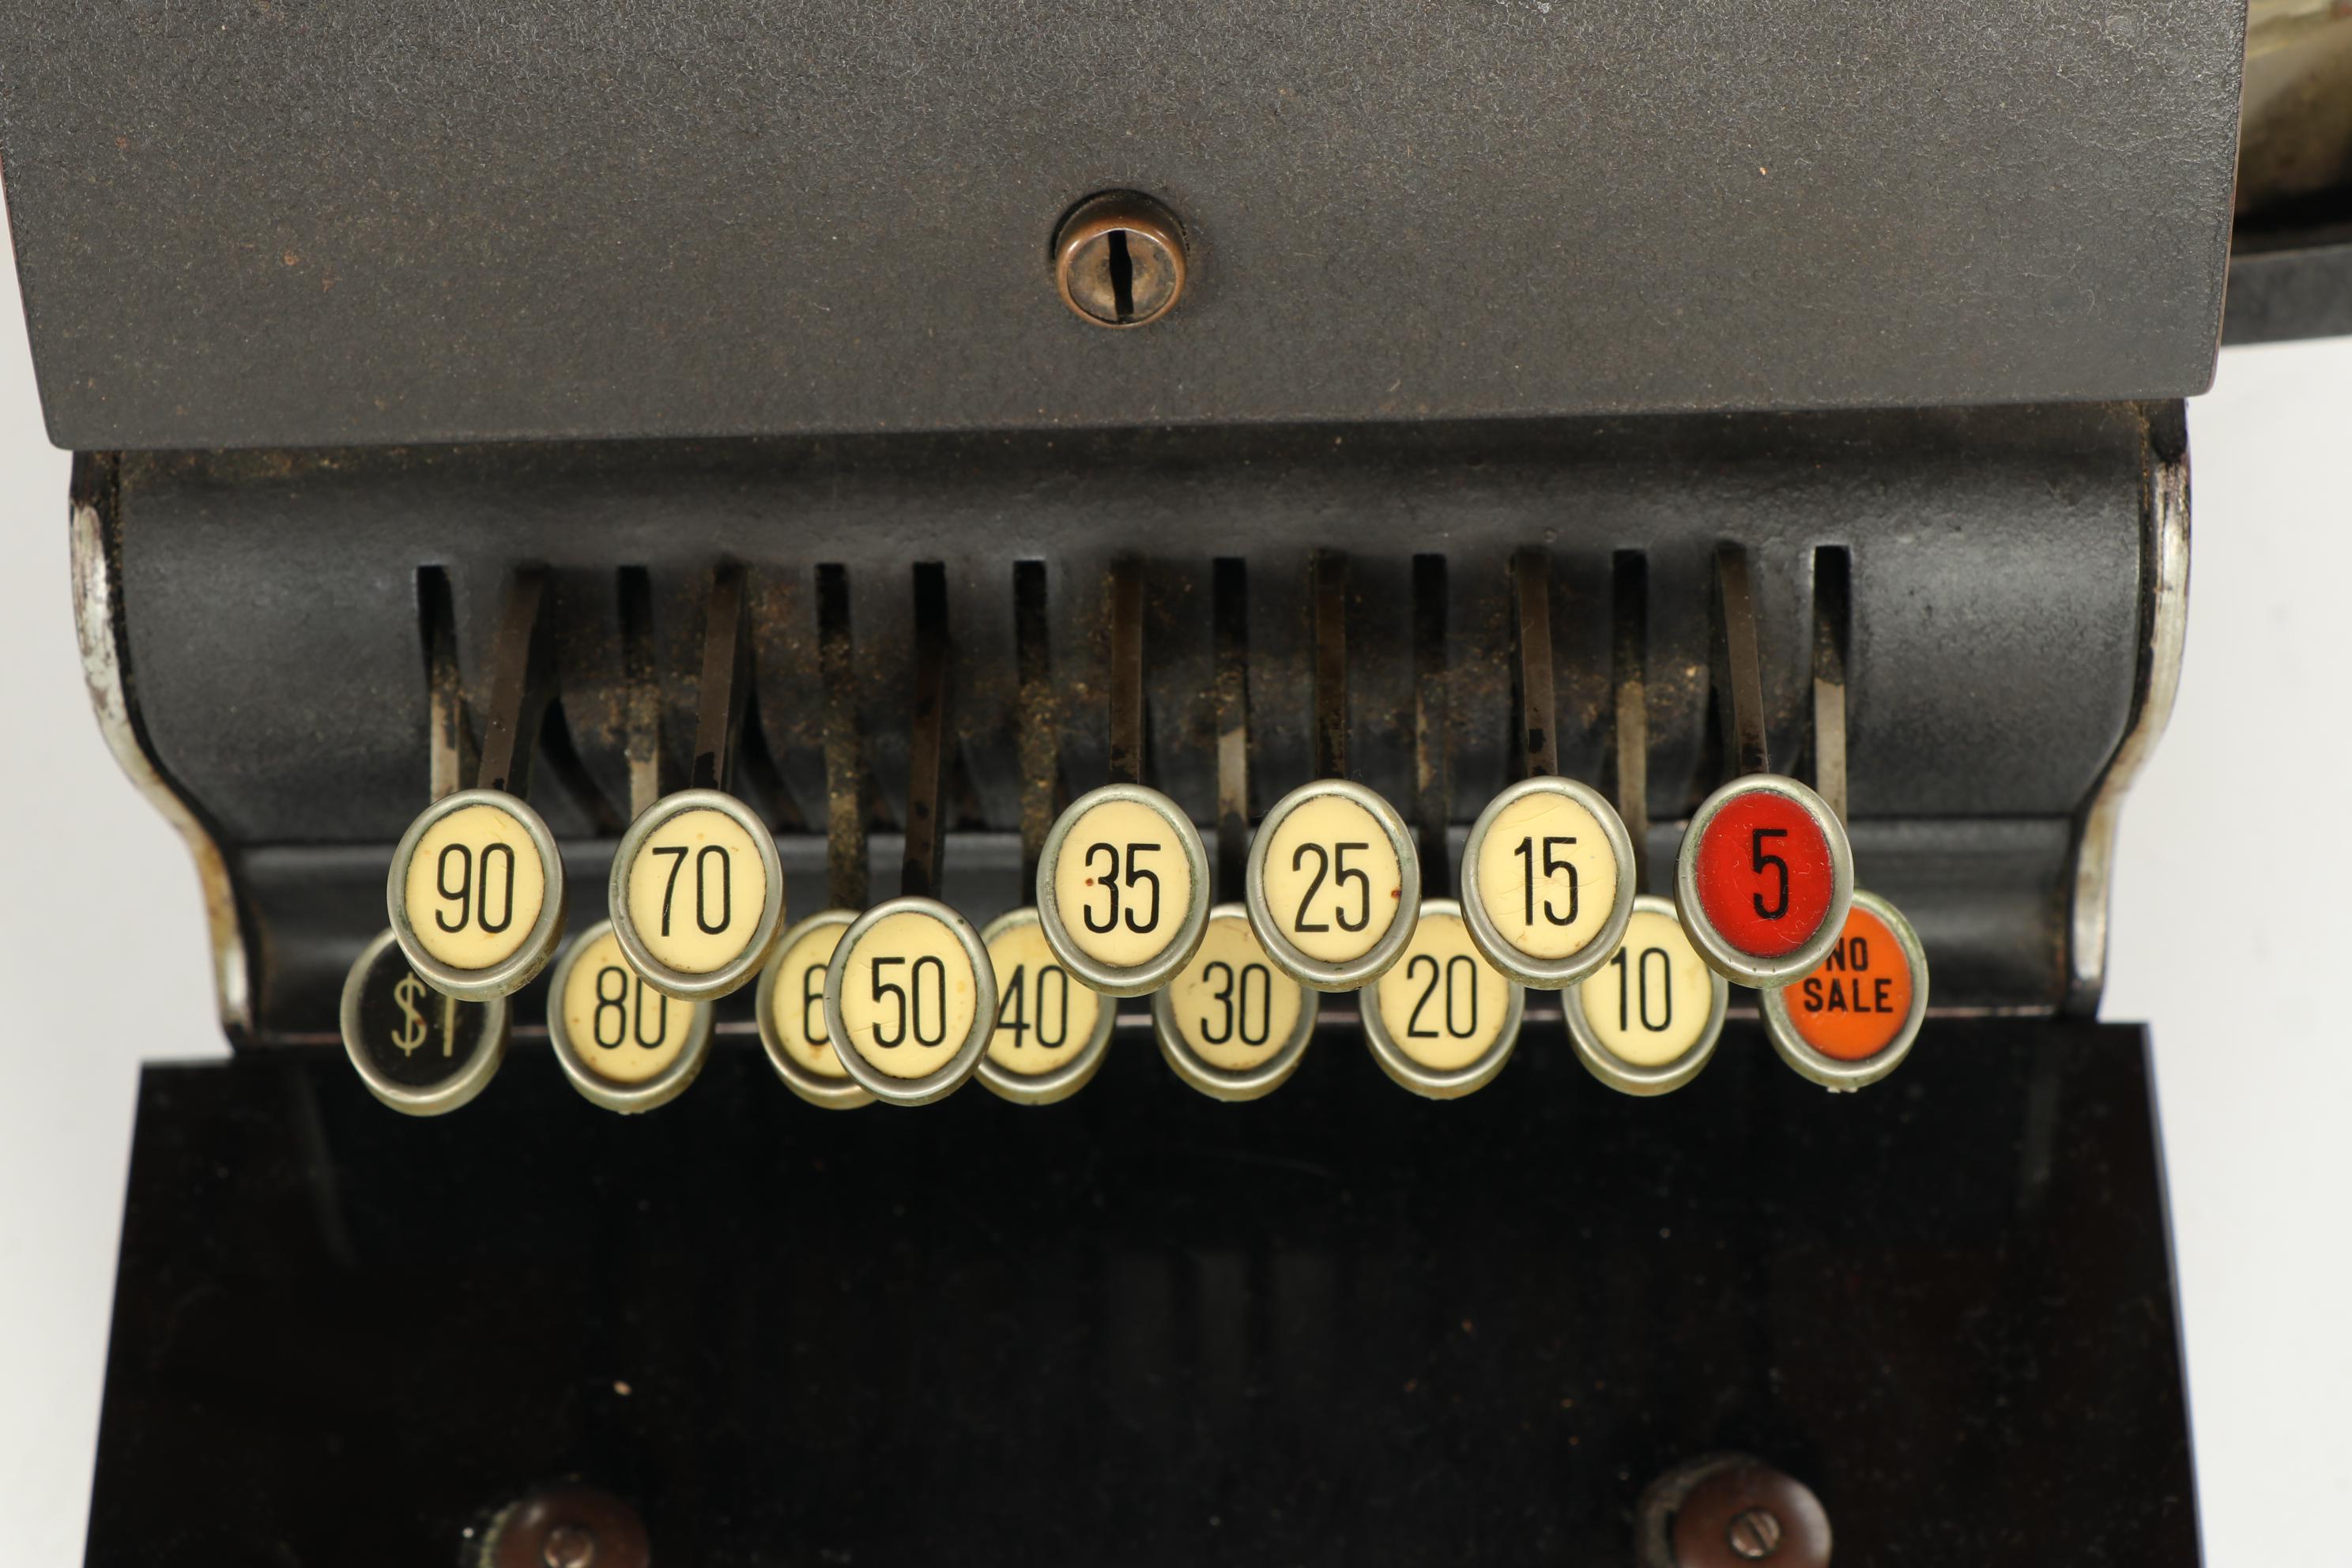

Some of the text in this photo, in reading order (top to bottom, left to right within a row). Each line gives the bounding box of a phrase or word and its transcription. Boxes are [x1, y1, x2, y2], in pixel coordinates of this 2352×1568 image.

[435, 842, 515, 934] 90
[652, 844, 731, 937] 70
[1084, 842, 1162, 934] 35
[1292, 842, 1370, 933] 25
[1513, 836, 1579, 926] 15
[1751, 828, 1788, 920] 5
[1407, 954, 1478, 1039] 20
[1610, 946, 1672, 1032] 10
[1803, 978, 1894, 1014] SALE
[1826, 937, 1868, 973] NO
[391, 972, 456, 1057] $1
[594, 966, 667, 1050] 80
[803, 963, 830, 1047] 6
[871, 956, 947, 1049] 50
[997, 964, 1069, 1049] 40
[1200, 961, 1272, 1047] 30
